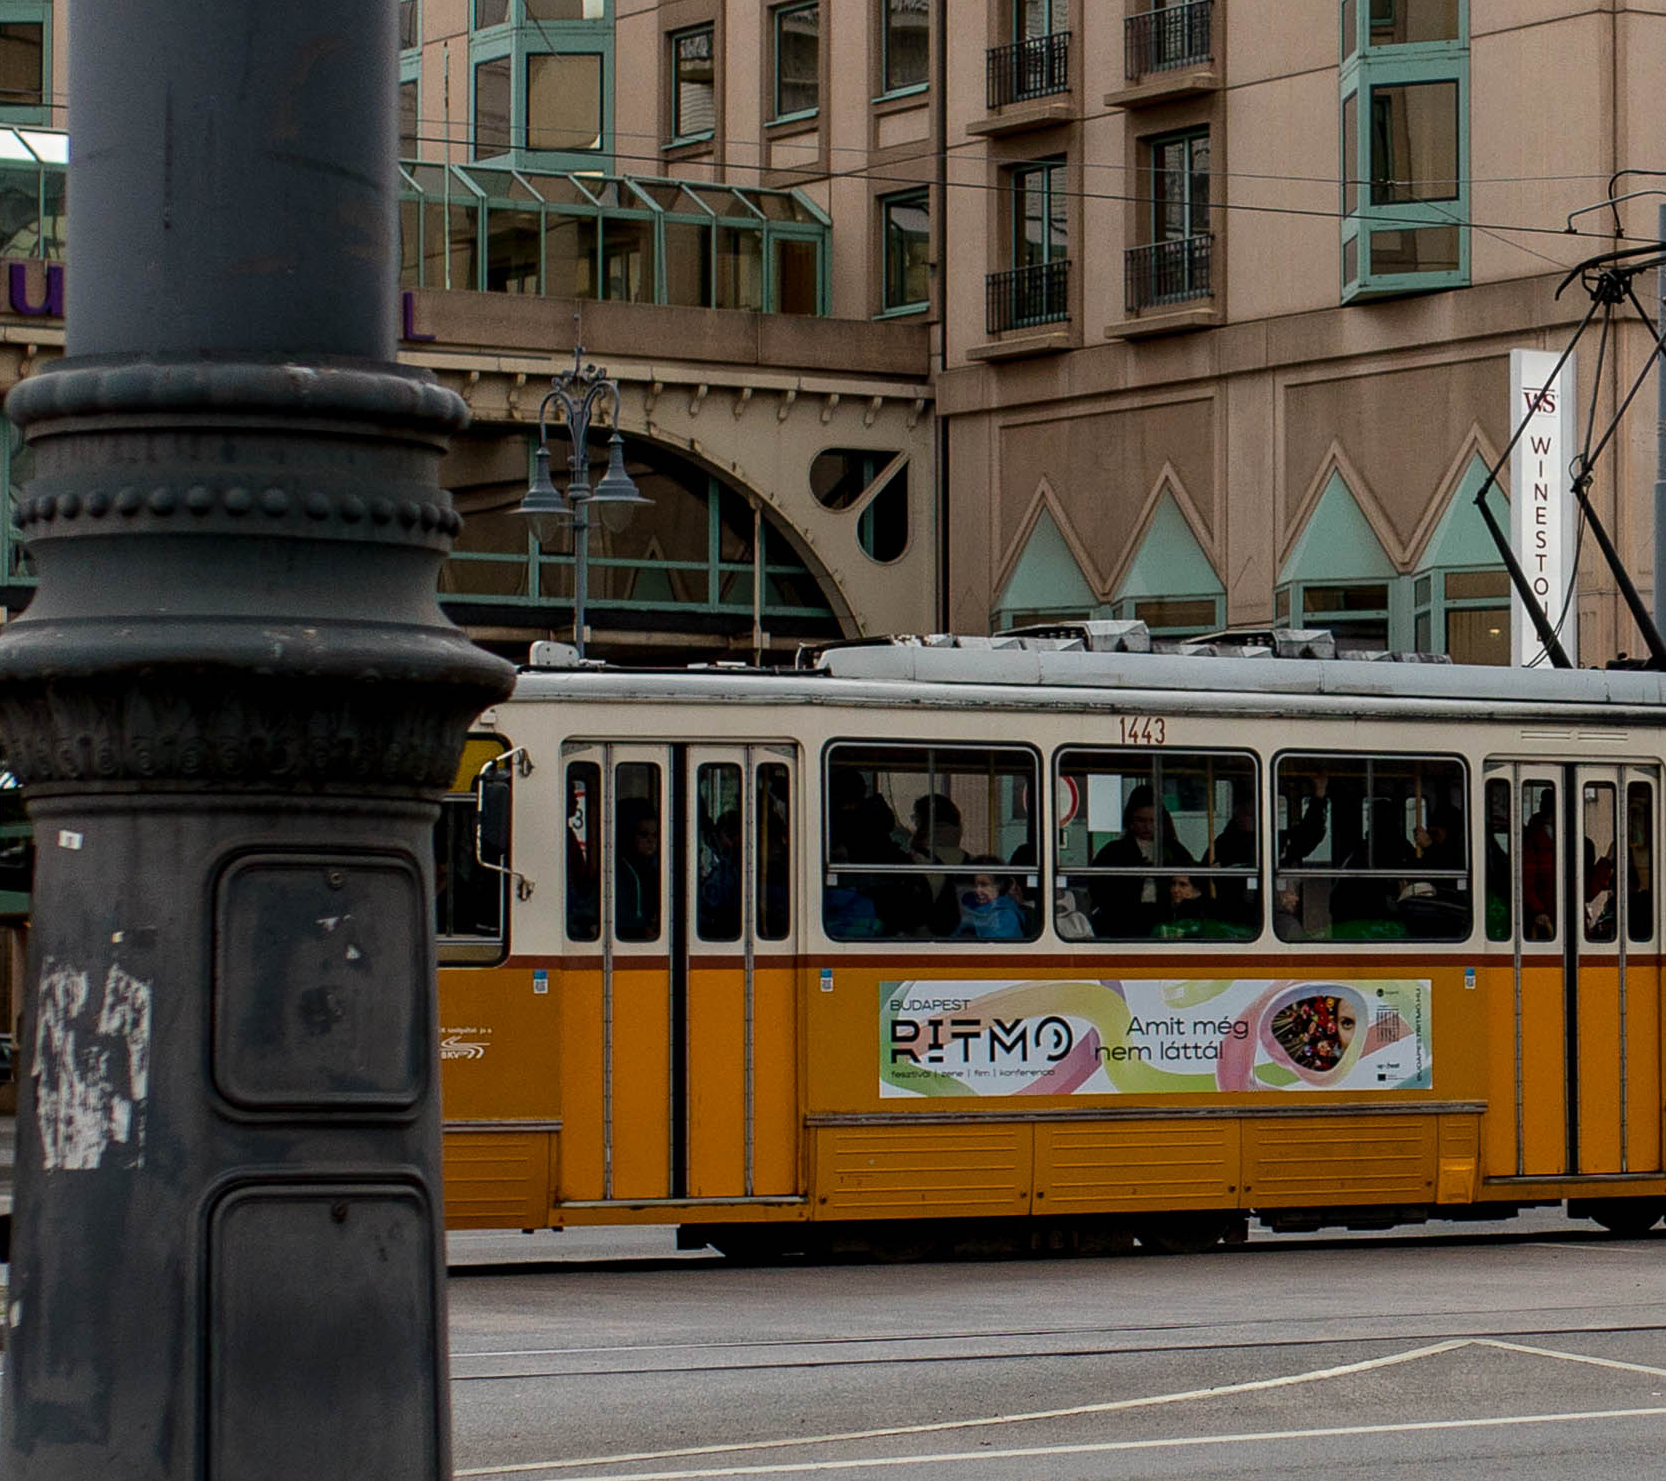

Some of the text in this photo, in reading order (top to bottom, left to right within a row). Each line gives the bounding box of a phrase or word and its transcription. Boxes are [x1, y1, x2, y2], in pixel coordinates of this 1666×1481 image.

[1530, 436, 1551, 642] WINESTO
[1119, 716, 1165, 744] 1443
[890, 999, 971, 1011] BUDAPEST
[891, 1016, 1074, 1063] RITMO
[1126, 1015, 1249, 1039] Amit még
[1094, 1041, 1223, 1061] nem láttál
